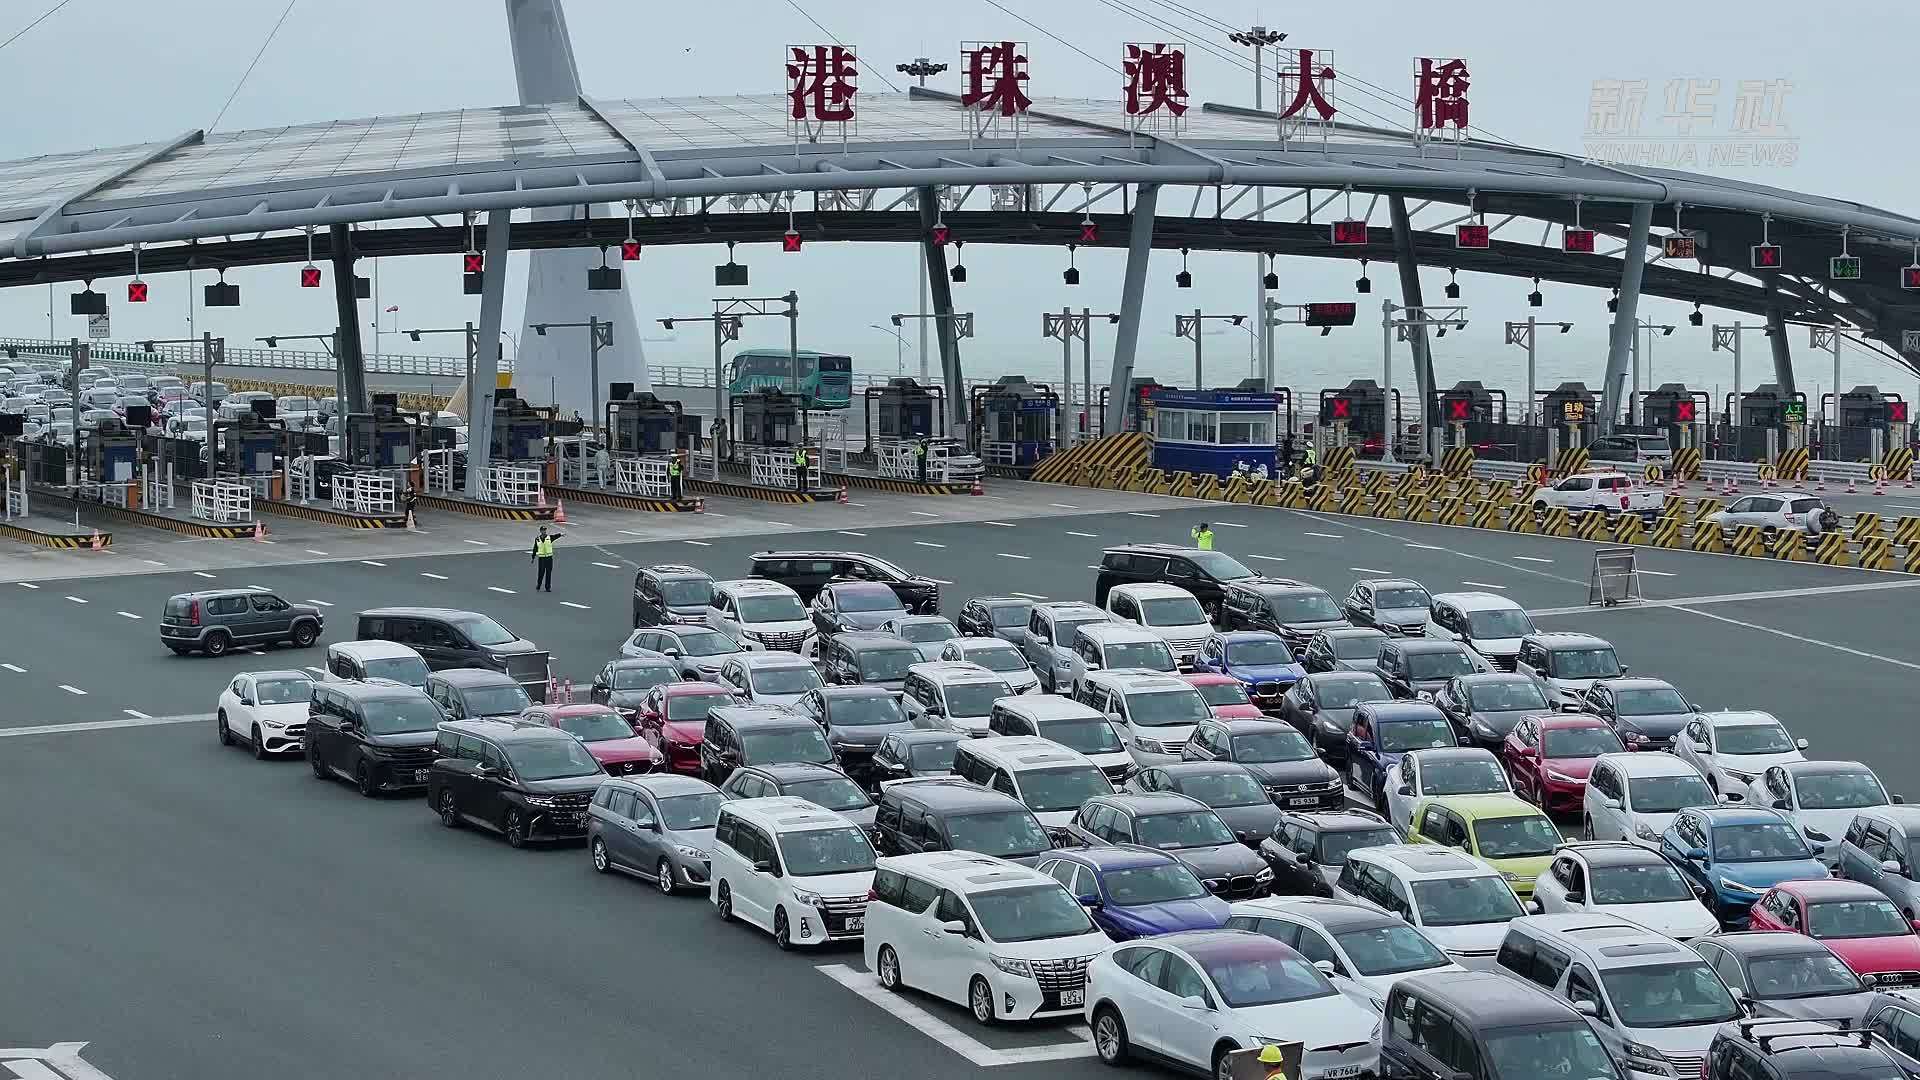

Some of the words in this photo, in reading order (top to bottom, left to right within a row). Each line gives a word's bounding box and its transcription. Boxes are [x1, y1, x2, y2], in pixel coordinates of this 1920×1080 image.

[786, 42, 1470, 128] 港珠澳大橋
[1564, 402, 1584, 412] 自动
[1785, 404, 1803, 414] 人工
